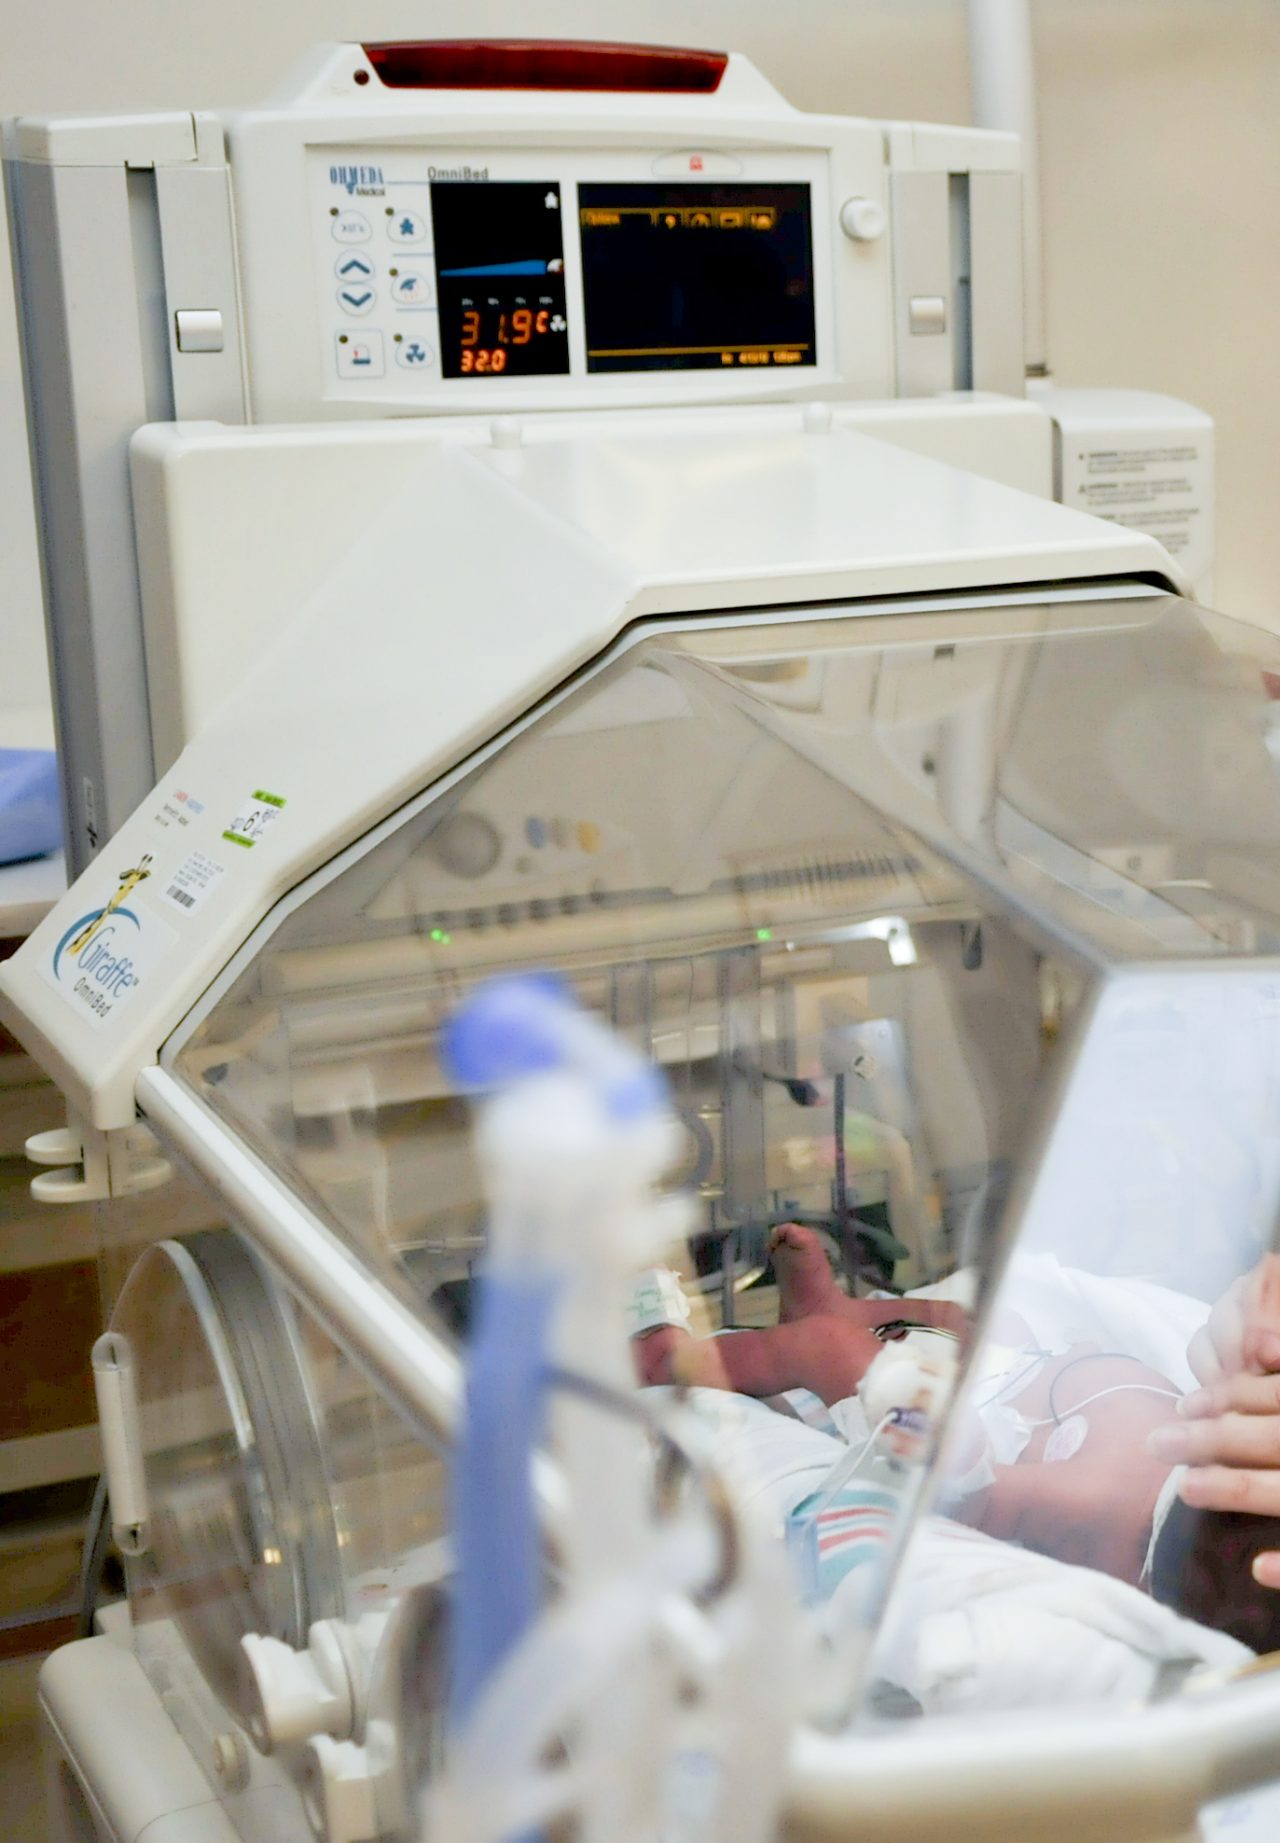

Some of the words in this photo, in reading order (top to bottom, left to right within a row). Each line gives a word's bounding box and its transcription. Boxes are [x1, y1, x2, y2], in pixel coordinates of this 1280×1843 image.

[329, 166, 384, 185] OHMEDA
[427, 166, 489, 180] OmniBed
[460, 349, 506, 373] 32.0
[73, 976, 113, 1018] OmniBed
